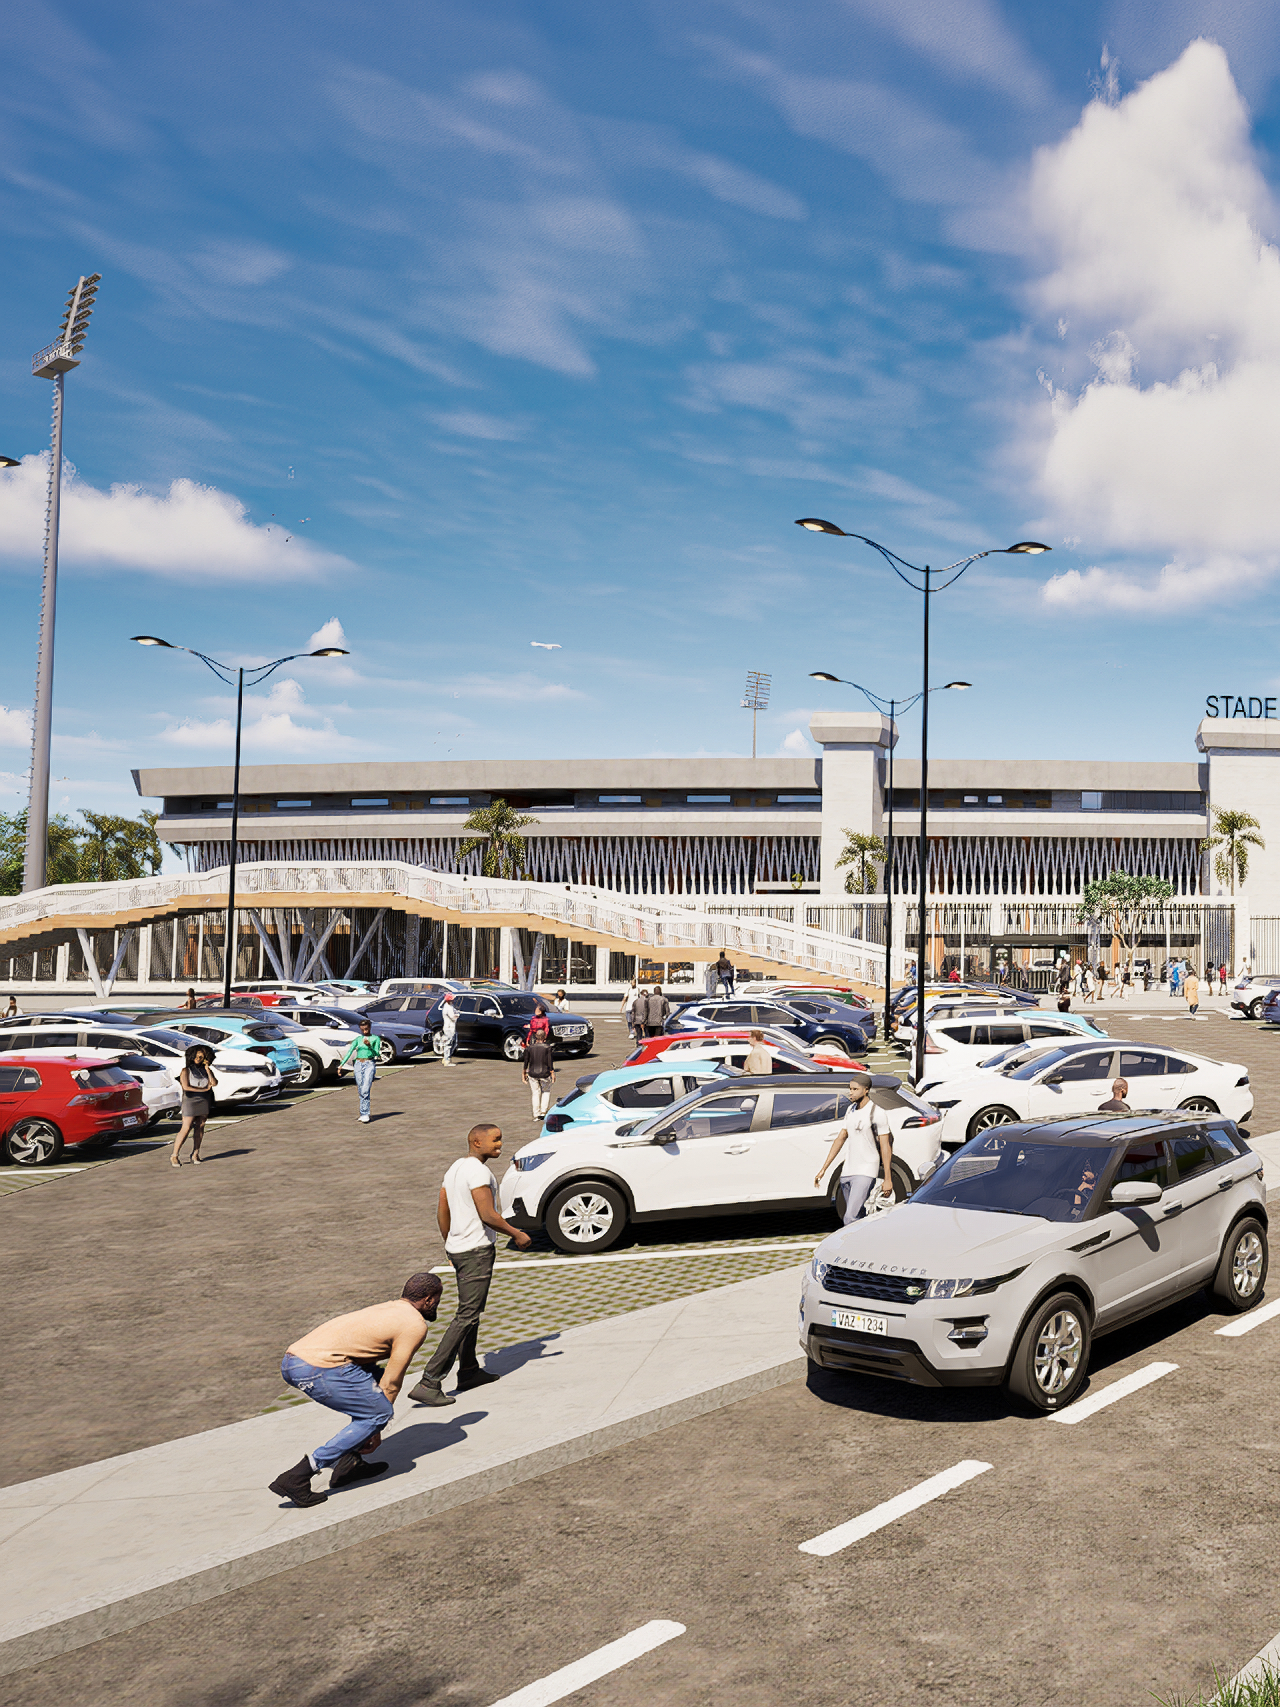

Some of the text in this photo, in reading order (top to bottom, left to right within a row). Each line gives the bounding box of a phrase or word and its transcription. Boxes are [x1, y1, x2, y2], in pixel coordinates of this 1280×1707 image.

[1205, 695, 1278, 719] STADE
[880, 1264, 927, 1275] ROVER
[838, 1313, 883, 1332] VAZ 1234
